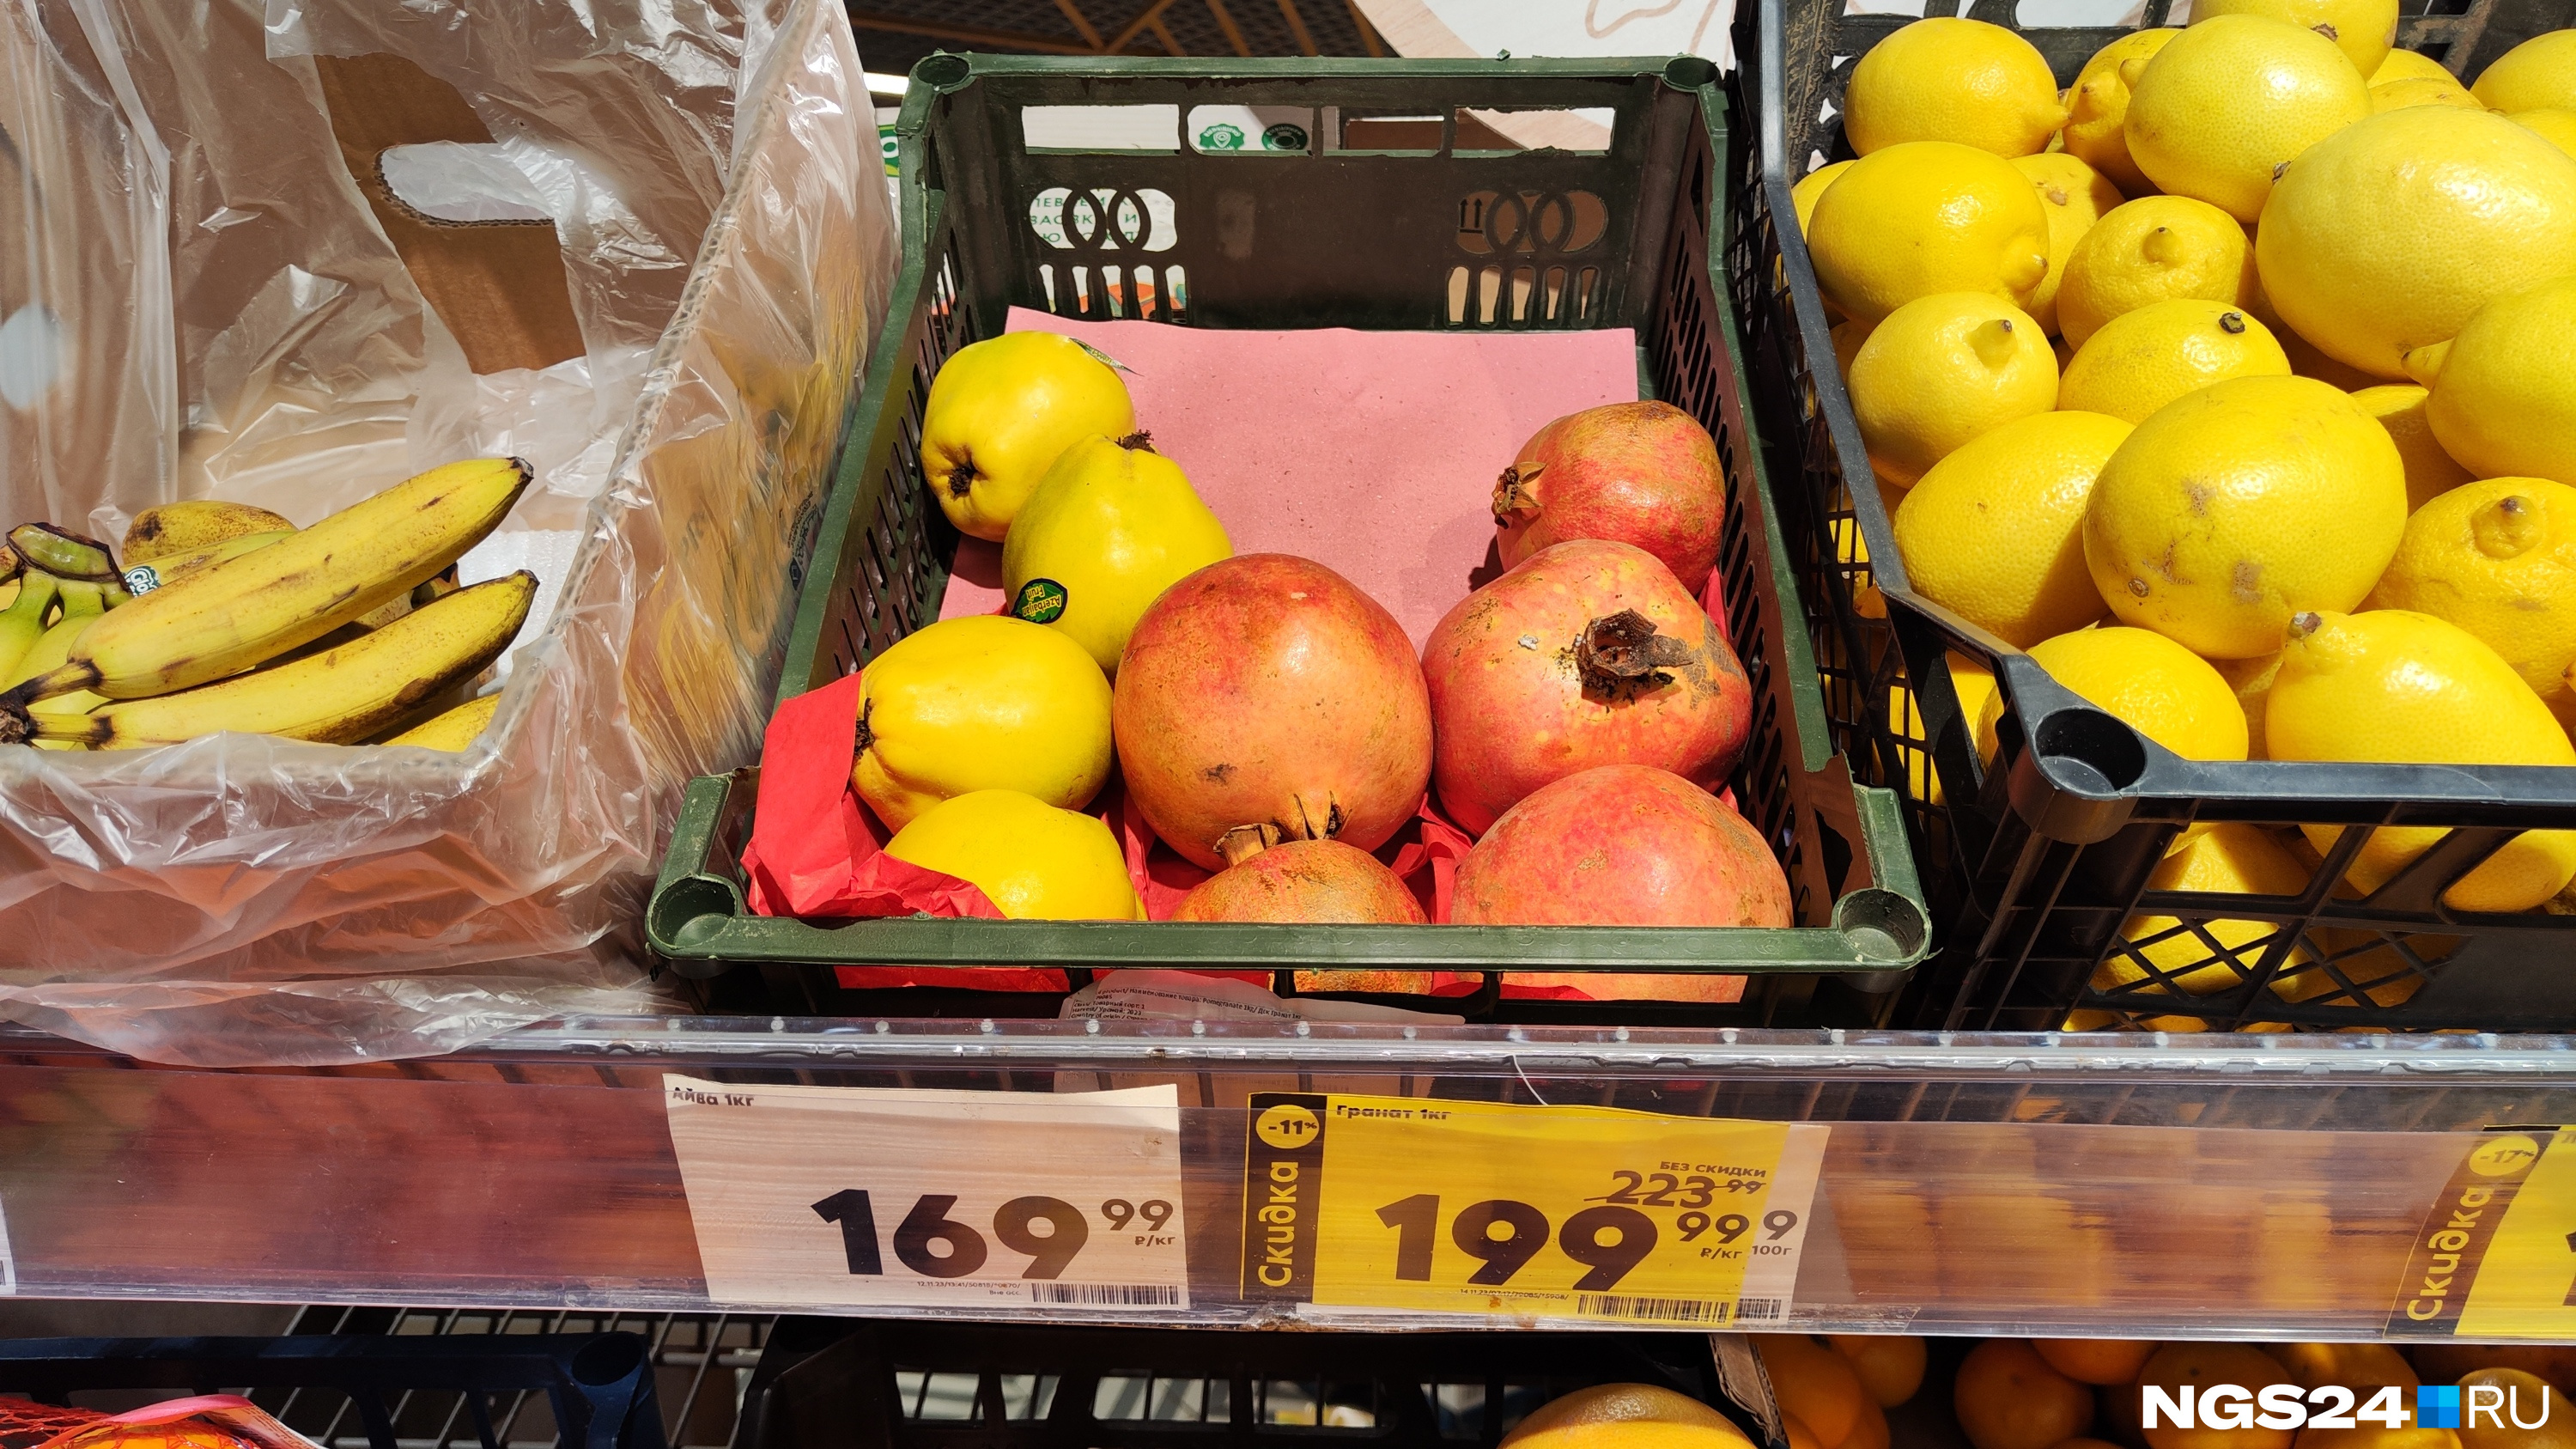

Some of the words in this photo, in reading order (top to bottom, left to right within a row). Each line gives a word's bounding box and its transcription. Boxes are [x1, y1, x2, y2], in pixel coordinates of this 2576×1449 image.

[1025, 585, 1045, 600] Fruit
[1023, 594, 1061, 616] Azerbaijan
[1202, 997, 1242, 1010] Pomegranate
[672, 1087, 720, 1105] Айва
[725, 1093, 755, 1106] 1кг
[1336, 1105, 1414, 1119] Гранат
[1419, 1109, 1452, 1120] 1кг
[1268, 1119, 1317, 1135] -11%
[2480, 1149, 2536, 1164] -17%
[1660, 1161, 1690, 1172] БЕЗ
[1695, 1164, 1766, 1178] СКИДКИ
[1606, 1170, 1716, 1209] 223
[1258, 1161, 1299, 1288] Скидка
[811, 1189, 1089, 1280] 169
[1101, 1198, 1174, 1232] 99
[1374, 1194, 1659, 1292] 199
[1676, 1211, 1750, 1244] 99
[1752, 1245, 1793, 1256] 100г
[2406, 1187, 2495, 1321] Скидка
